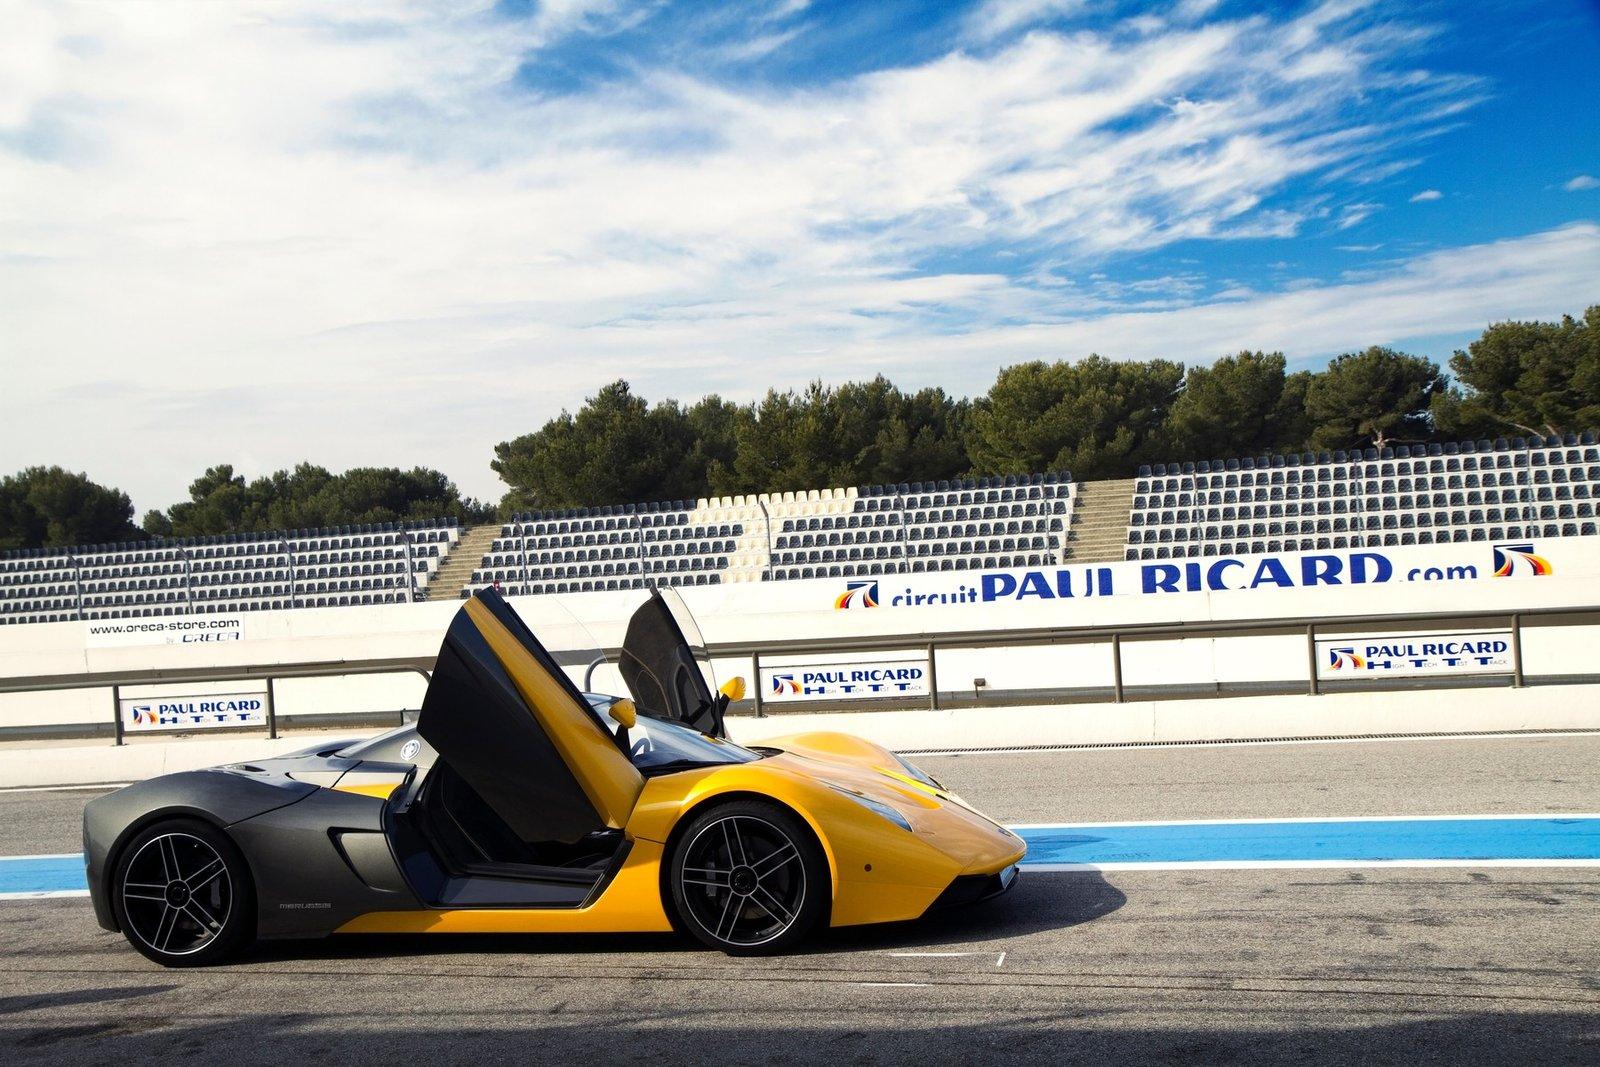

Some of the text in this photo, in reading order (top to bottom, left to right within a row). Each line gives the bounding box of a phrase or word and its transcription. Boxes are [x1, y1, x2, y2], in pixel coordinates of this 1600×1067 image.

[1141, 553, 1394, 594] RICARD
[90, 619, 240, 635] www.oreca-store.com
[182, 631, 240, 643] ORECA
[1366, 640, 1508, 658] PAUL RICARD
[803, 668, 923, 684] PAUL RICARD
[159, 699, 261, 715] PAUL RICARD
